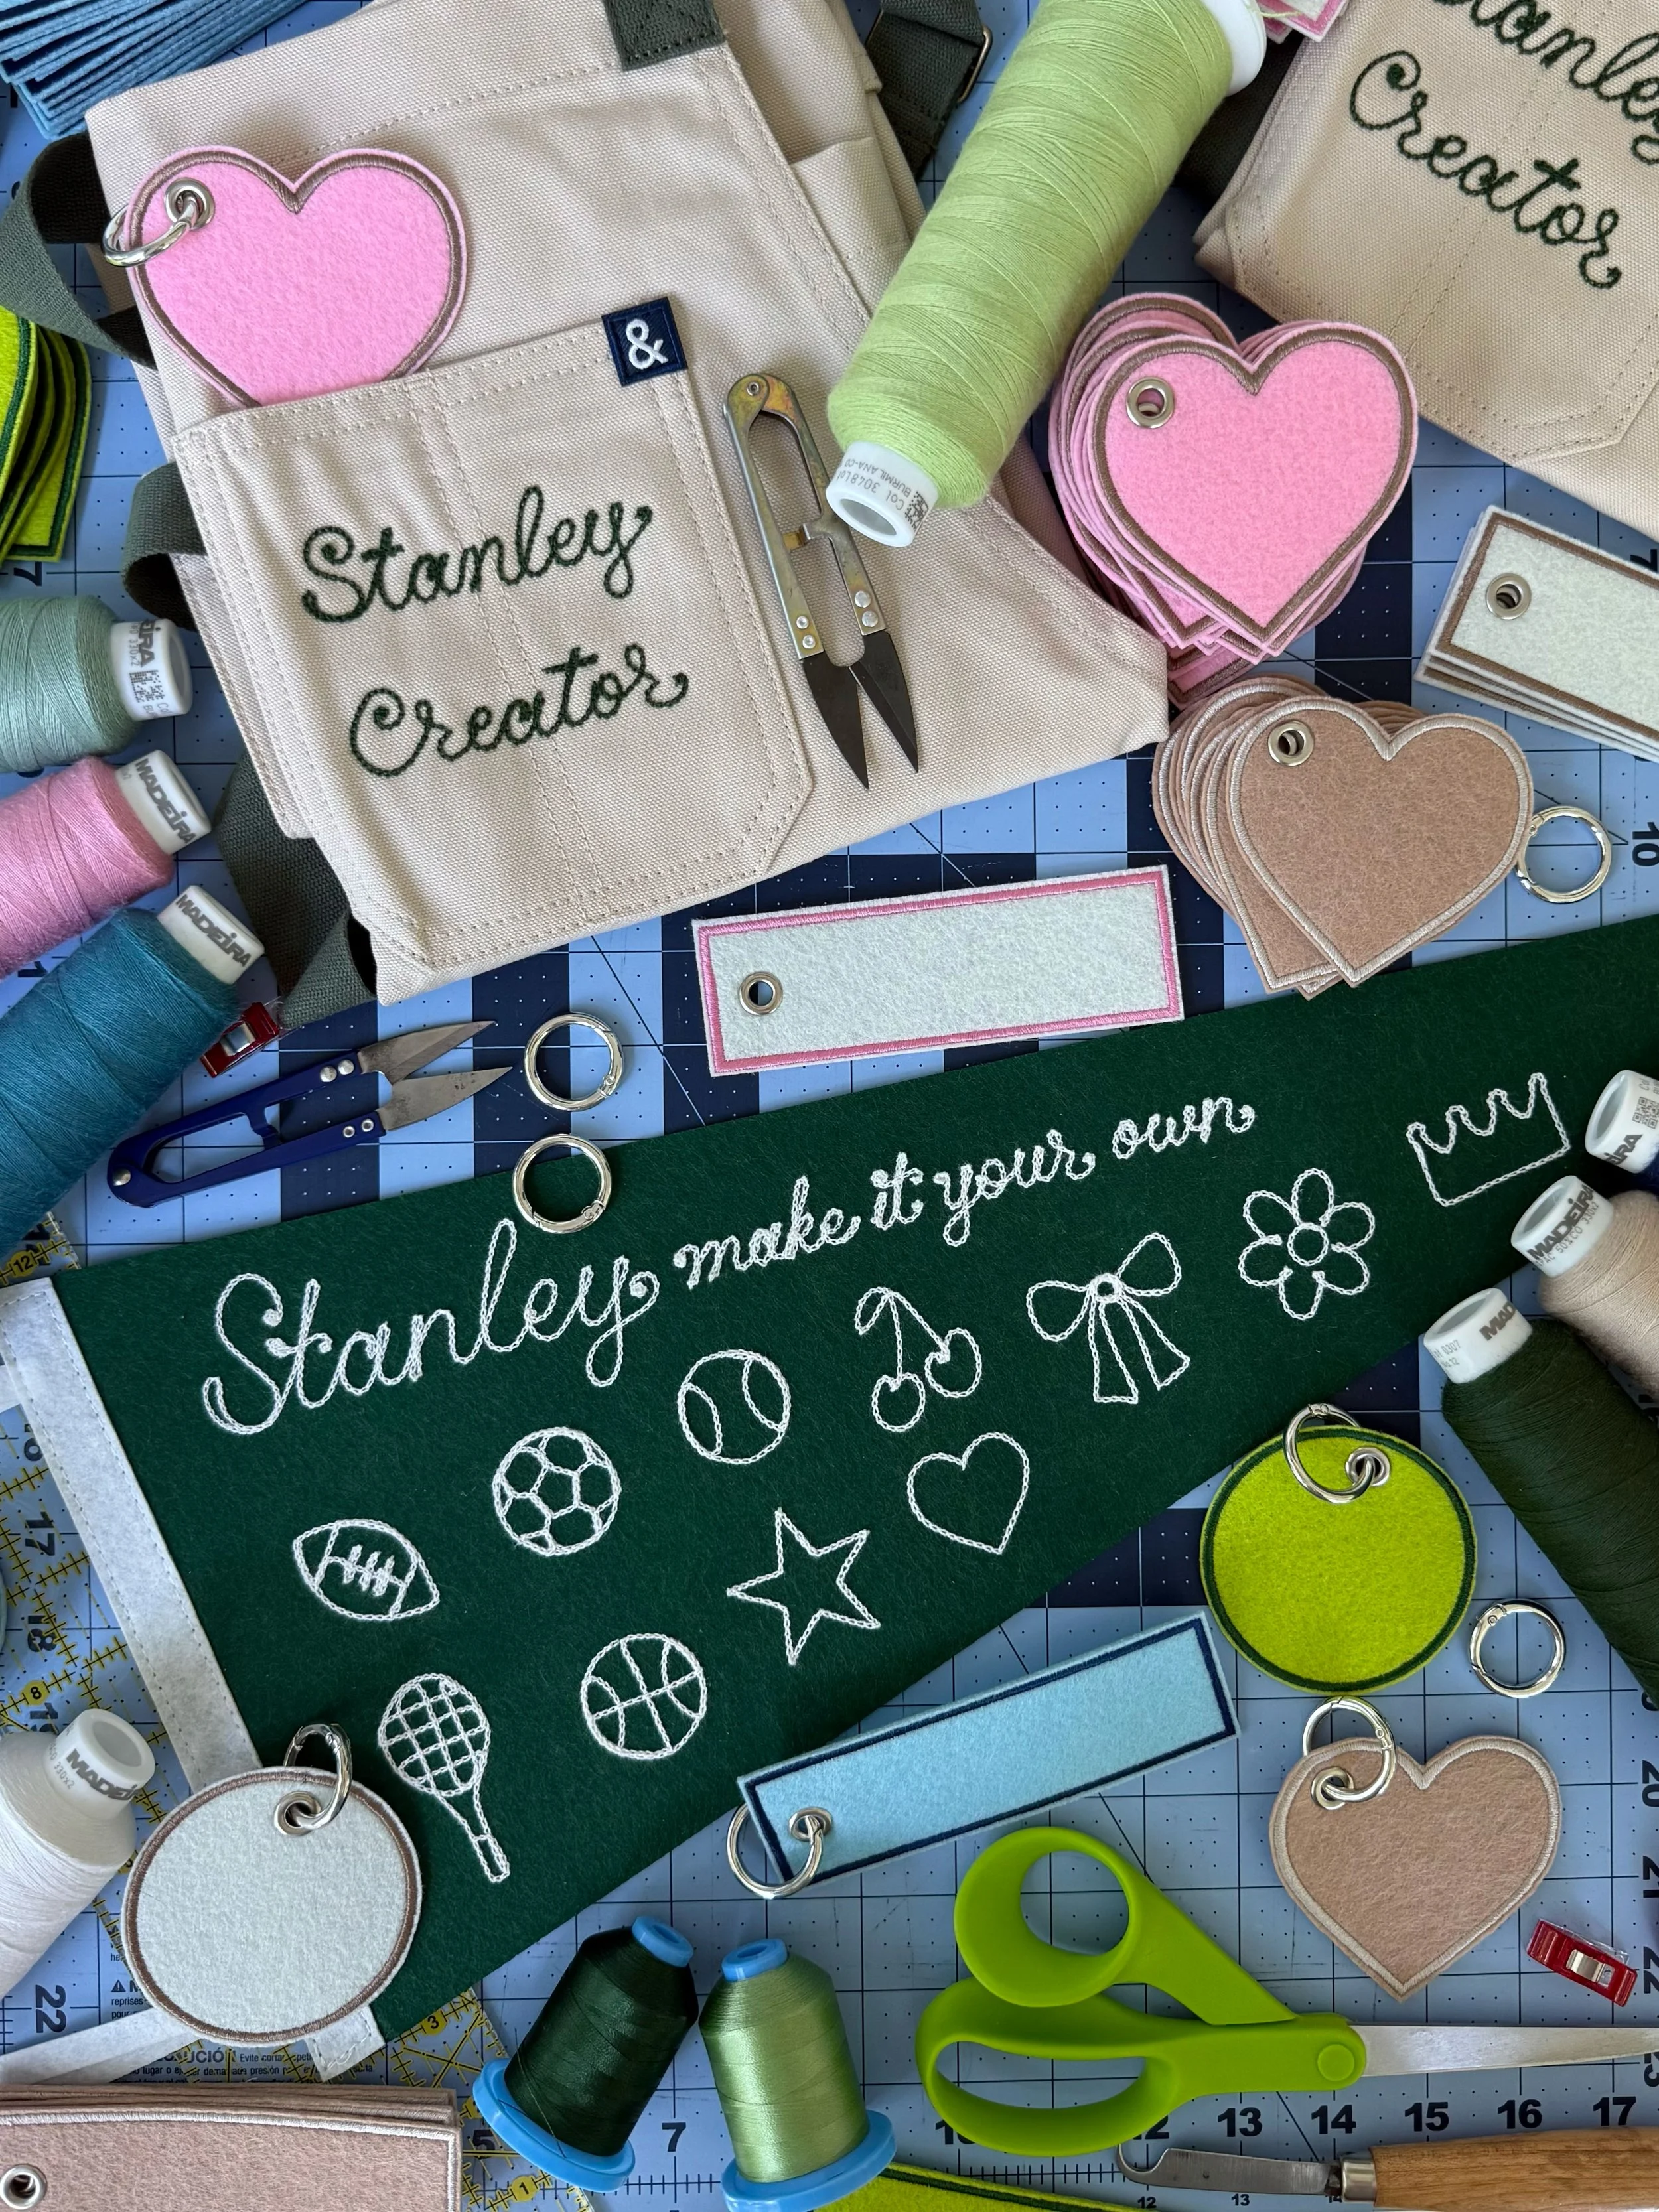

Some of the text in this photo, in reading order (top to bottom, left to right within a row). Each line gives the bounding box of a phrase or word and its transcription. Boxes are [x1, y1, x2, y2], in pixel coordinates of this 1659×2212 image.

[1350, 50, 1622, 289] Creator
[628, 318, 668, 370] &
[302, 486, 653, 624] Stanley
[13, 561, 42, 586] 7
[348, 643, 689, 778] Creator
[1632, 822, 1659, 866] 10
[13, 1255, 34, 1273] 12
[202, 1096, 1256, 1435] Stanley make it your own
[25, 1511, 55, 1556] 17
[27, 1612, 57, 1652] 18
[30, 1686, 42, 1700] 8
[35, 1984, 66, 2034] 22
[427, 2015, 439, 2029] 3
[143, 2067, 163, 2075] lugar
[240, 2054, 259, 2063] Evite
[1218, 2107, 1262, 2138] 13
[1311, 2105, 1356, 2135] 14
[1404, 2101, 1449, 2132] 15
[1498, 2099, 1542, 2129] 16
[1593, 2096, 1636, 2127] 17
[473, 2129, 496, 2160] 5
[662, 2122, 686, 2152] 7
[518, 2182, 530, 2195] 1
[1137, 2197, 1157, 2209] 12
[1231, 2193, 1250, 2206] 13
